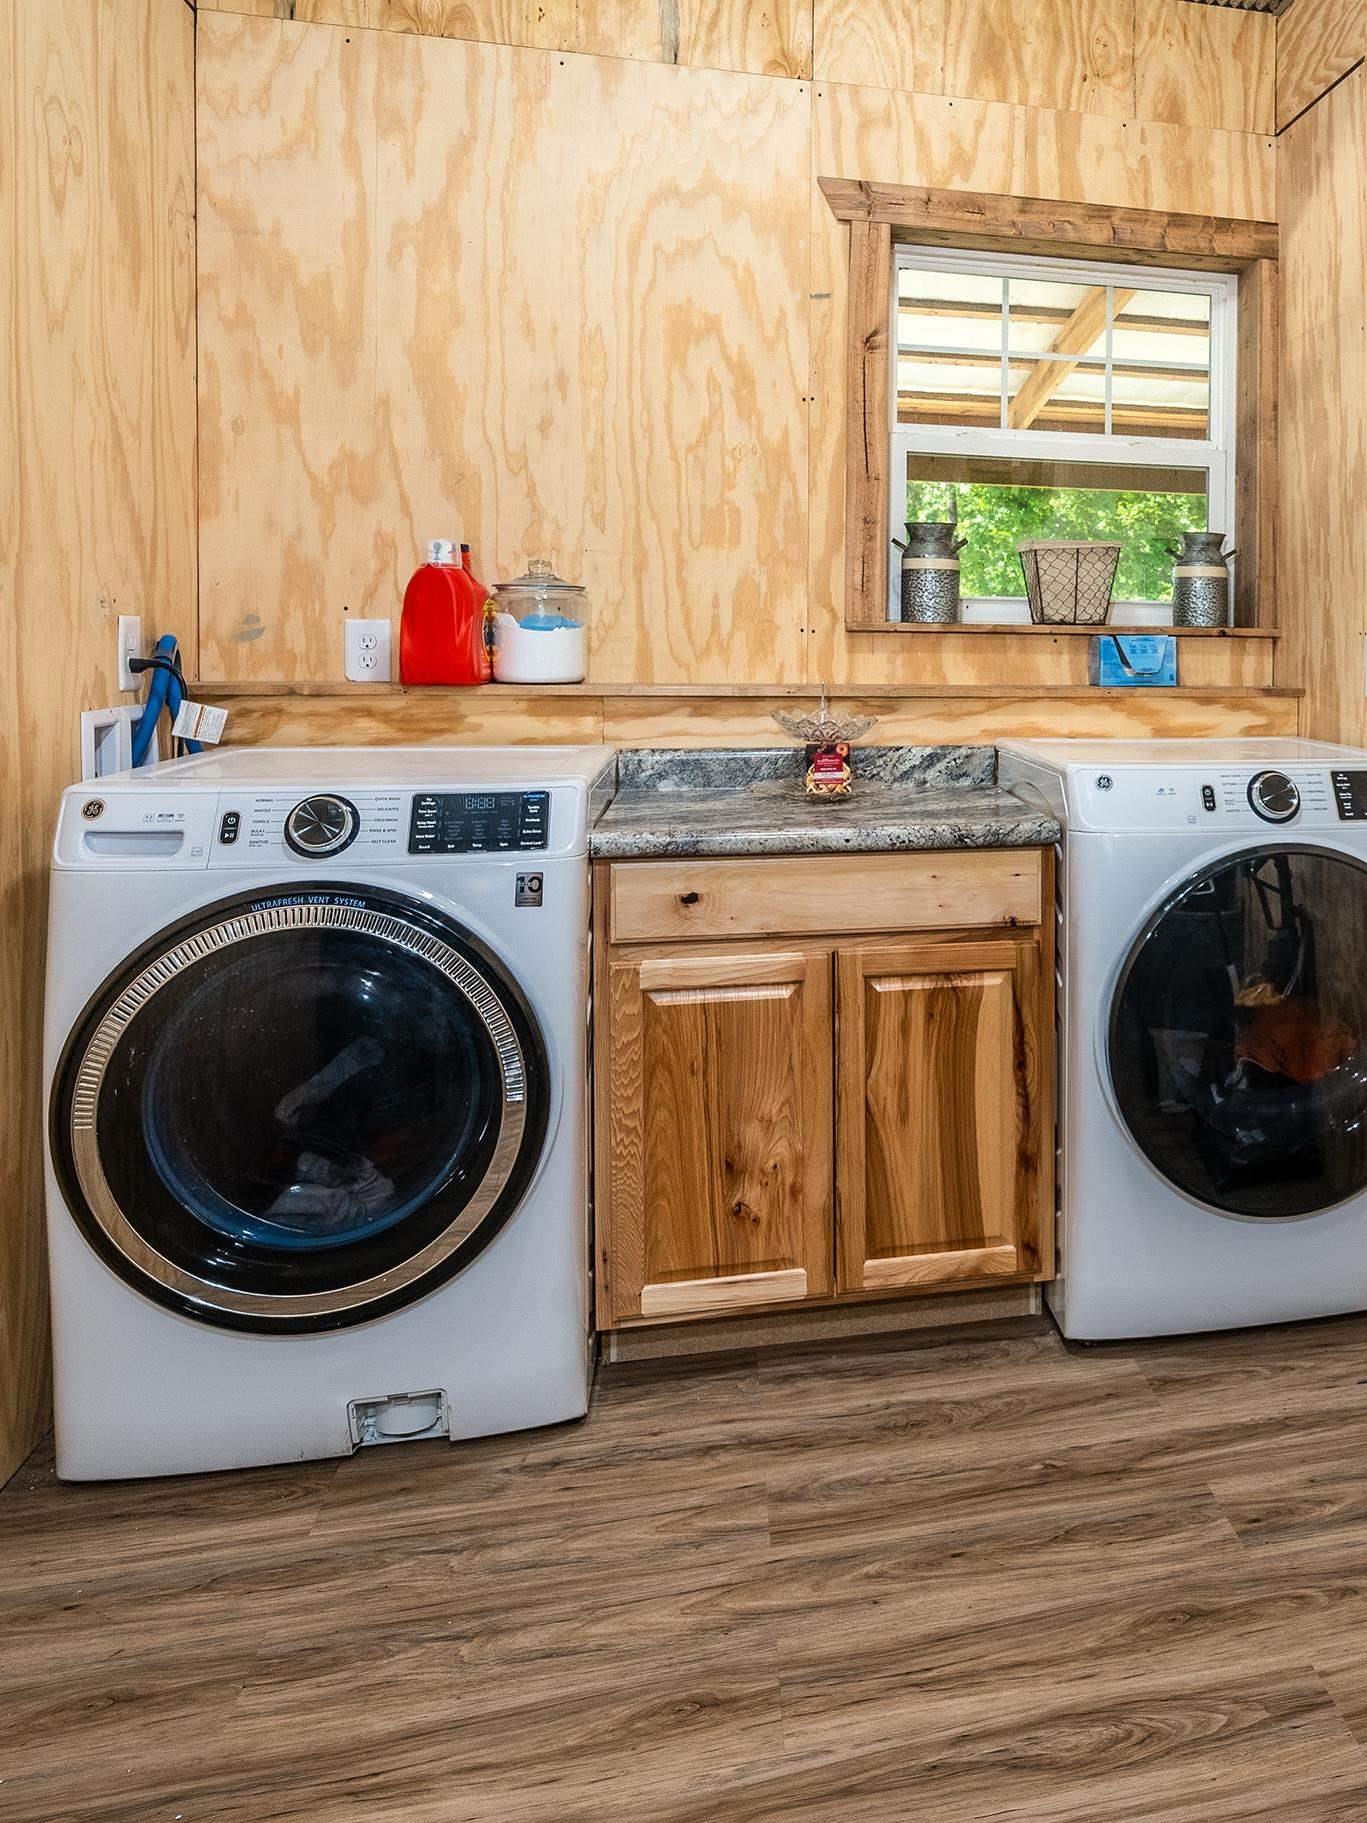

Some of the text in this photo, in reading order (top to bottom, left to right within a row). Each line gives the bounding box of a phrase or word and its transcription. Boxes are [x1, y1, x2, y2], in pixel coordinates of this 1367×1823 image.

[251, 895, 366, 912] ULTRAFRESH VENT SYSTEM
